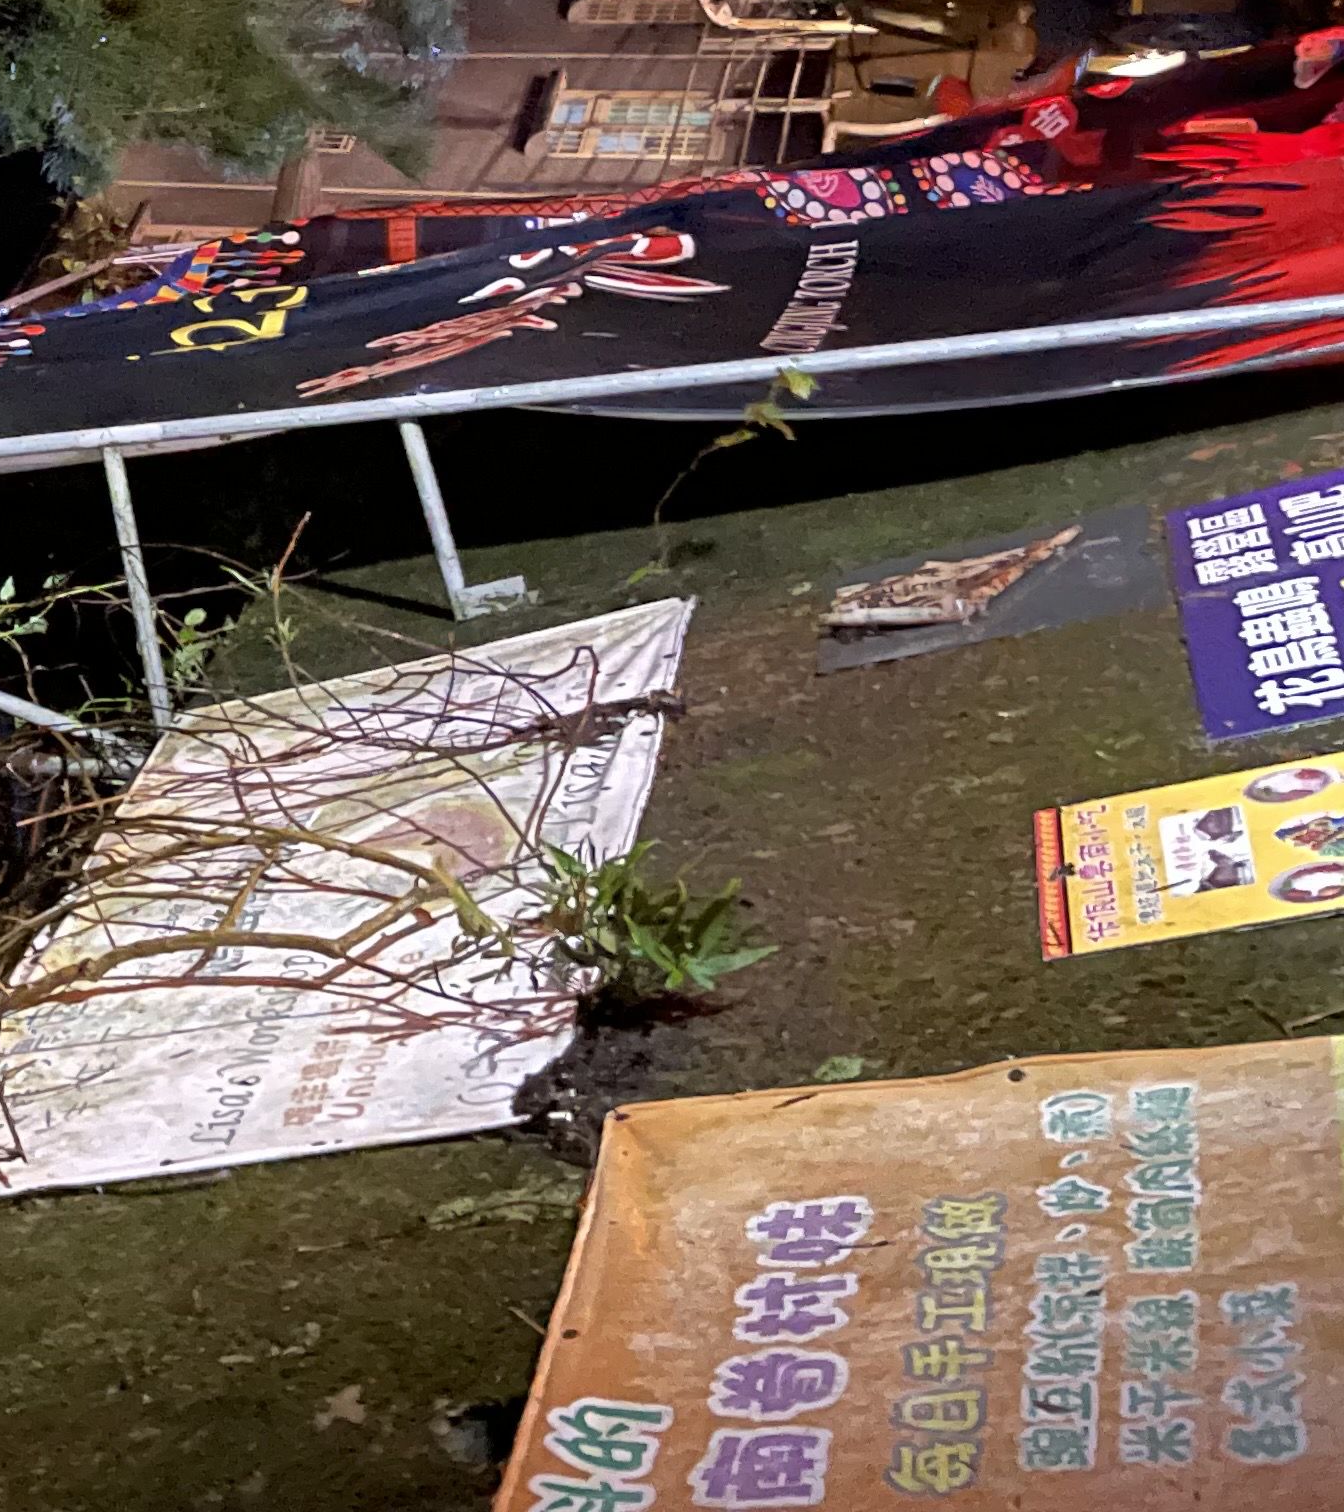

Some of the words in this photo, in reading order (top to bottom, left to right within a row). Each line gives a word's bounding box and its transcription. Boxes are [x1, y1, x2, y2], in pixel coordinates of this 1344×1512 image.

[1186, 504, 1278, 585] 露營區
[1232, 576, 1344, 715] 花鳥蟲鳴
[687, 1198, 872, 1509] 南眷村味
[884, 1193, 1009, 1496] 每日手工現做
